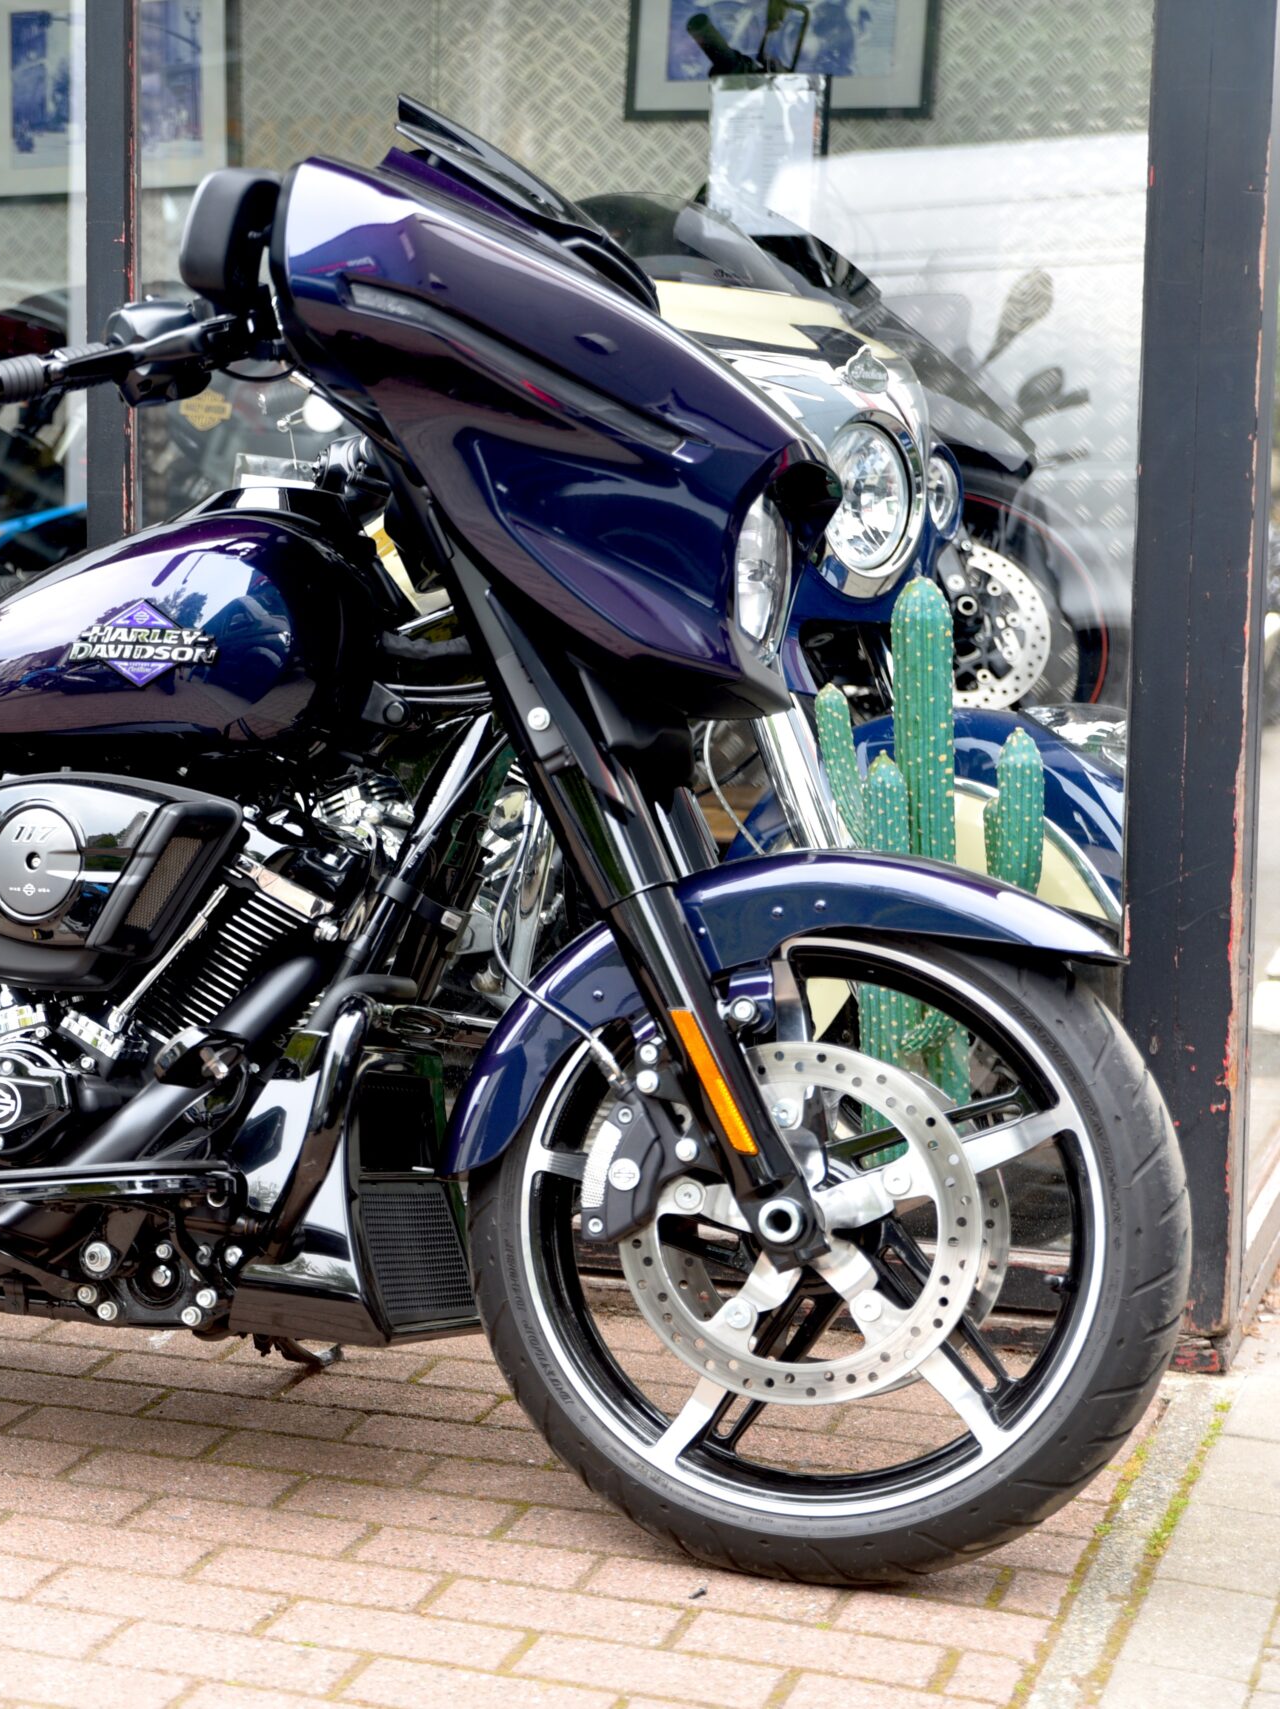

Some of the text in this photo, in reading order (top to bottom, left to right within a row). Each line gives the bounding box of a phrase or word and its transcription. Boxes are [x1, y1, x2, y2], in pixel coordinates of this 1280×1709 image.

[80, 625, 209, 645] HARLEY-
[70, 642, 218, 664] DAVIDSON
[11, 825, 57, 843] 117
